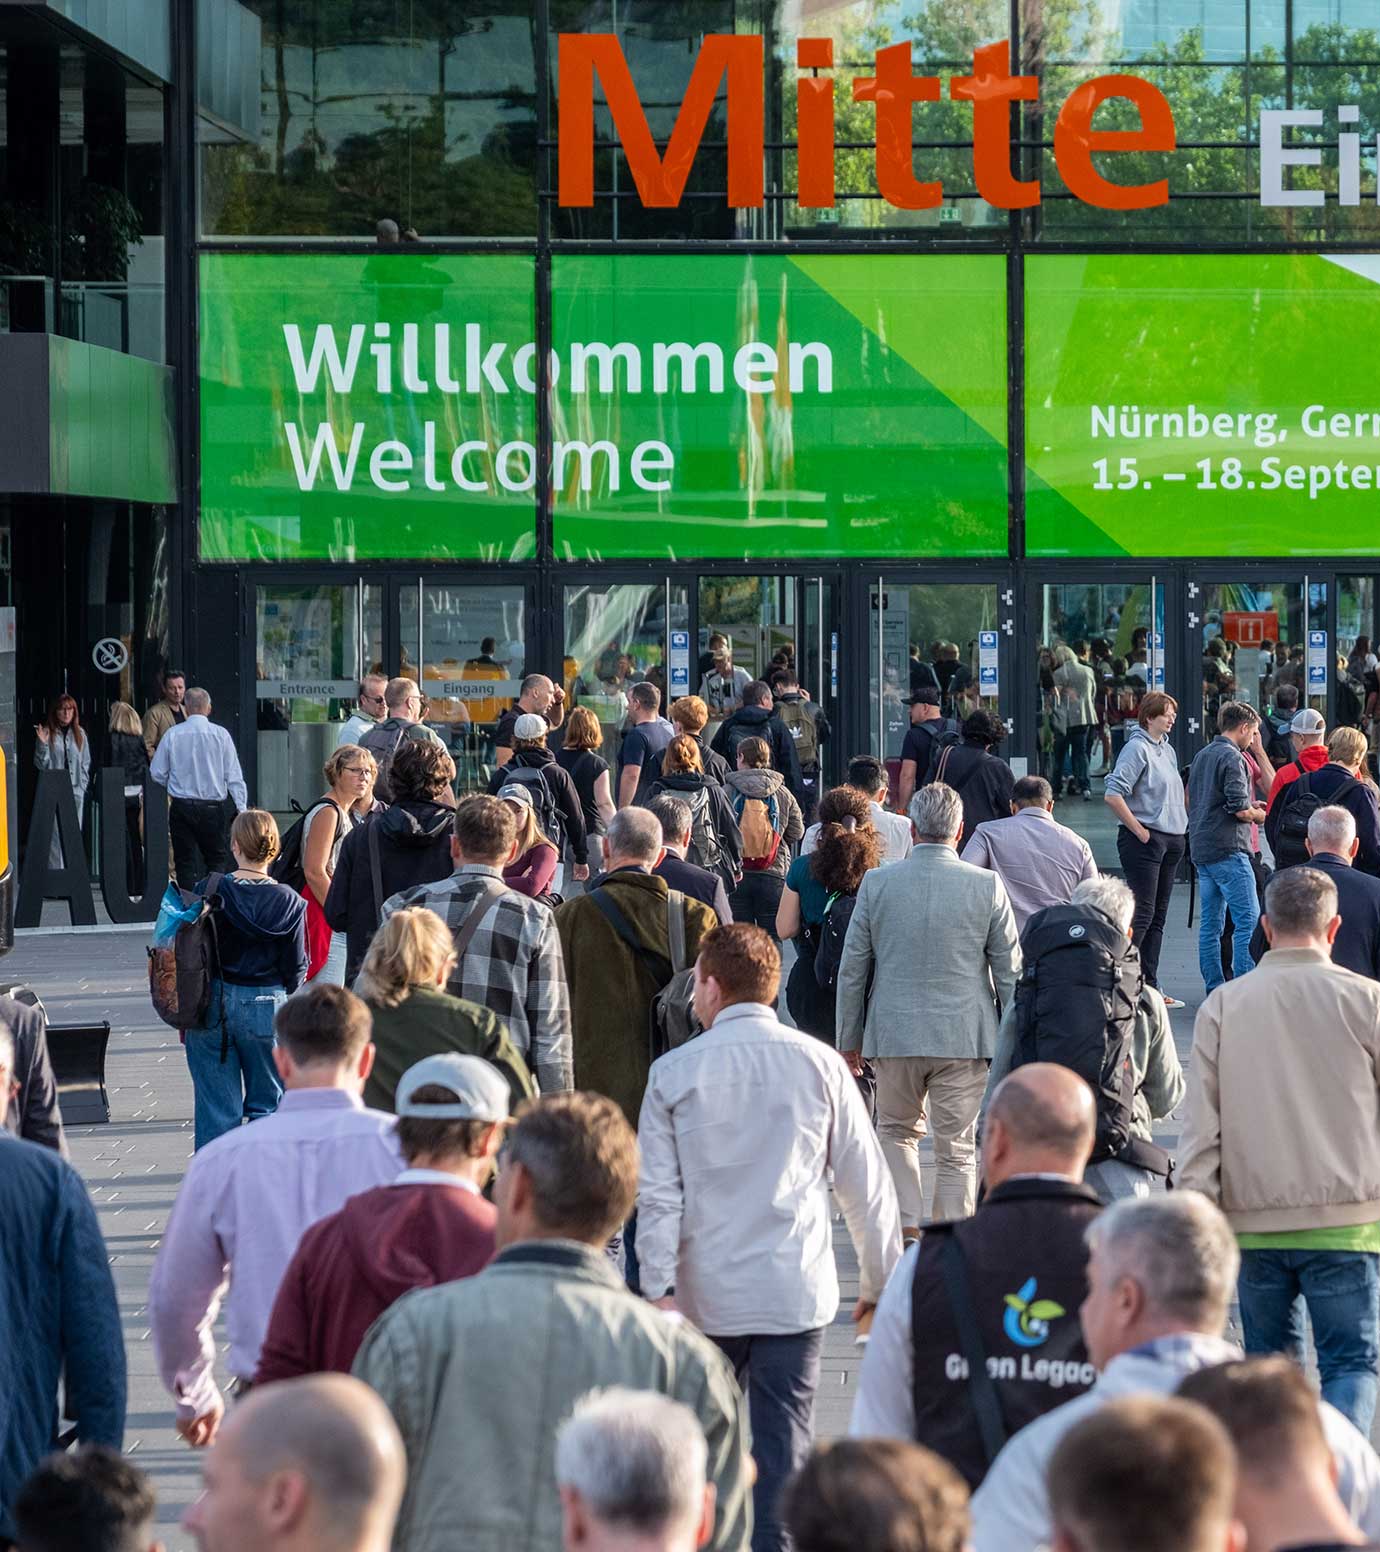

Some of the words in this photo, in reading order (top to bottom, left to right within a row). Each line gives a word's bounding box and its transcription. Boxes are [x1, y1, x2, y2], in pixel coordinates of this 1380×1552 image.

[558, 33, 1176, 210] Mitte
[283, 322, 833, 393] Willkommen
[1091, 405, 1287, 447] Nürnberg,
[284, 420, 676, 492] Welcome
[280, 683, 335, 695] Entrance
[443, 682, 495, 696] Eingang
[1021, 1353, 1095, 1388] Legac
